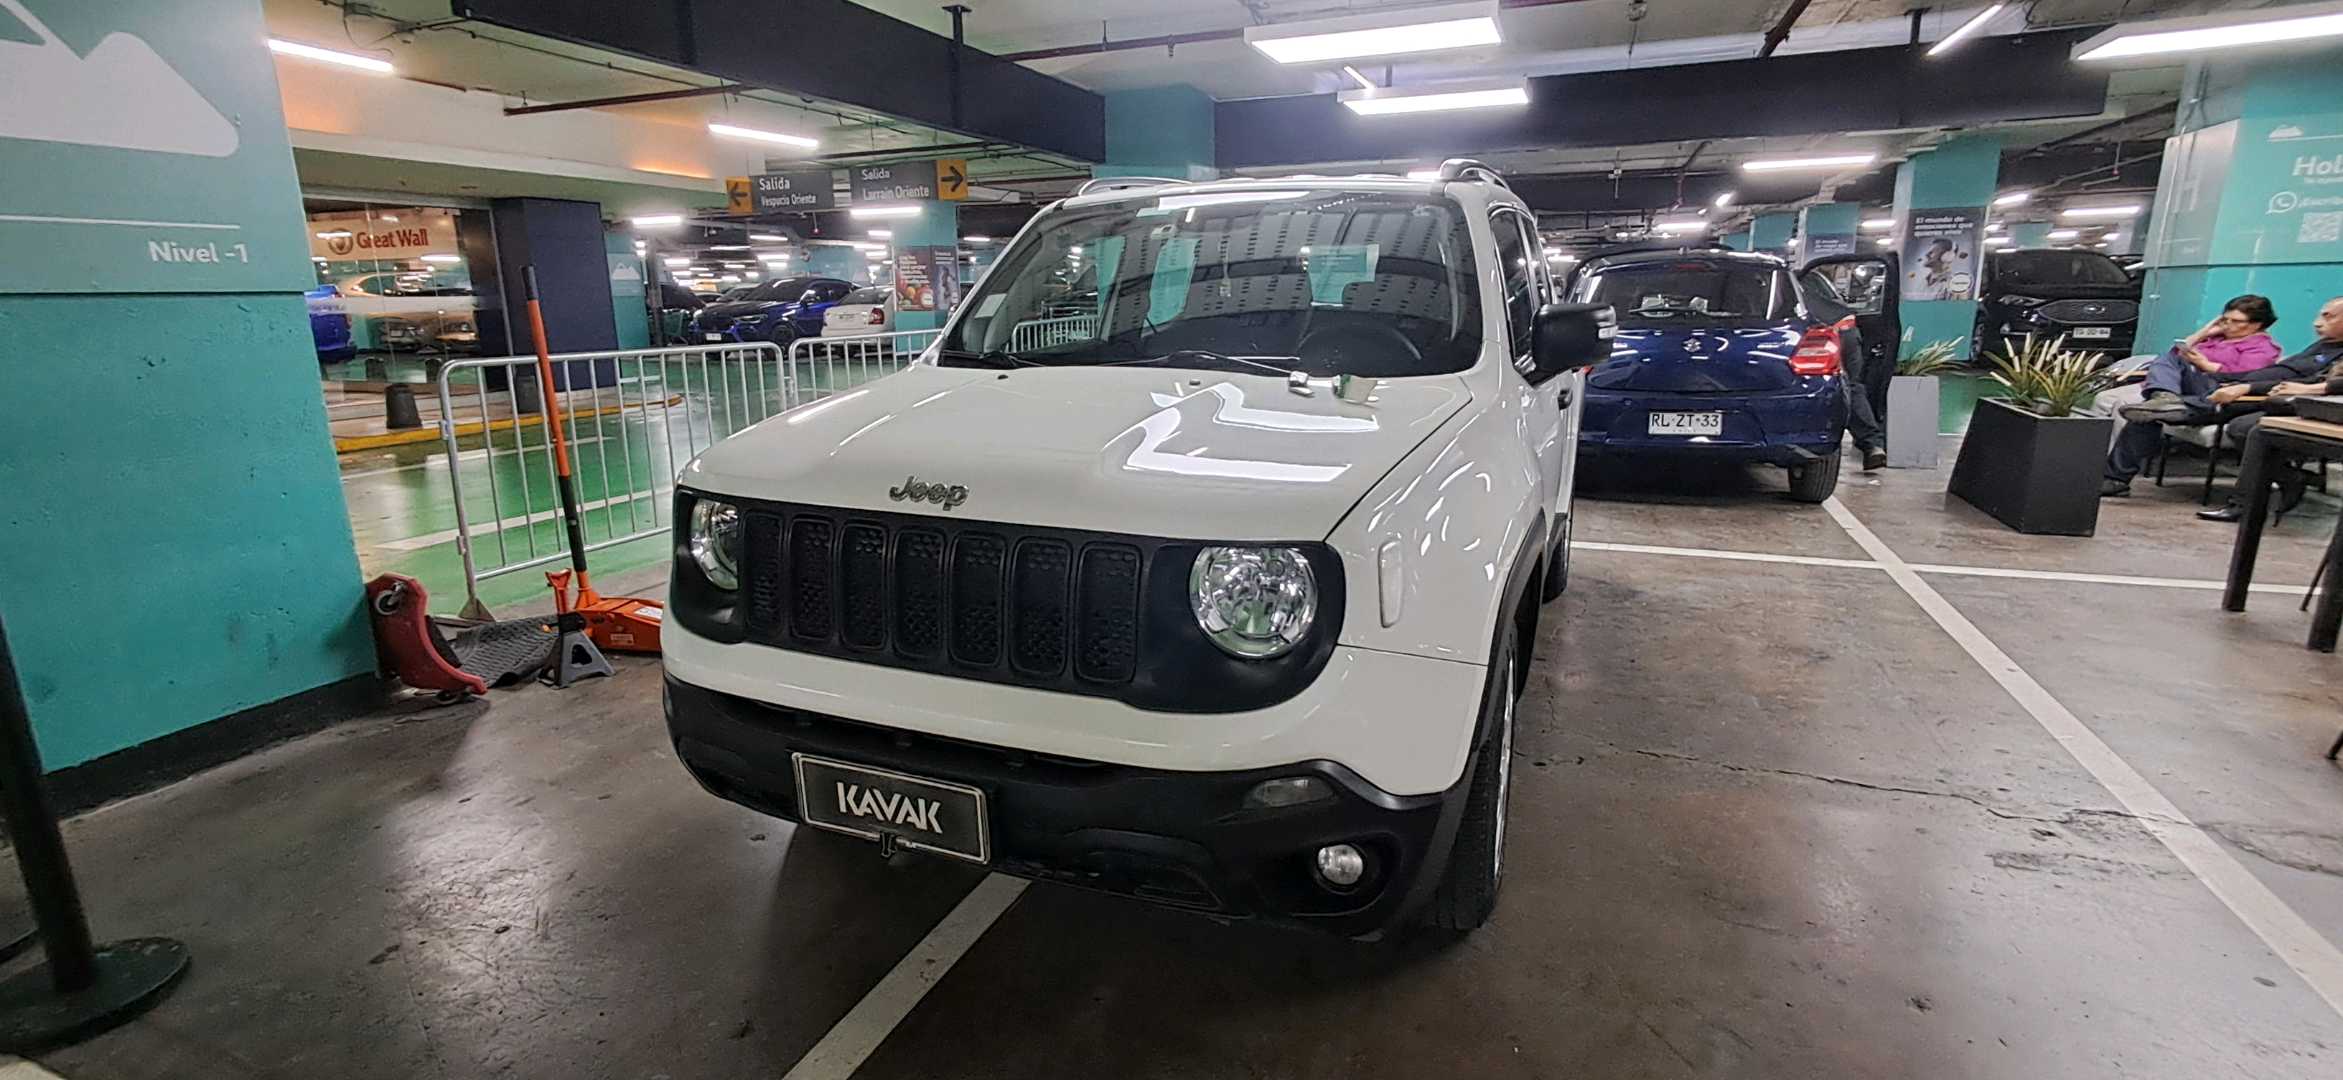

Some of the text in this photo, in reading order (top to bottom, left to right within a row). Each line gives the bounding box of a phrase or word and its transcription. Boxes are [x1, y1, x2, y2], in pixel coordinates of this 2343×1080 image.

[862, 168, 890, 180] Salida
[2292, 154, 2343, 176] Hol
[759, 177, 790, 191] Salida
[895, 184, 930, 199] Oriente
[791, 192, 817, 205] Oriente
[356, 228, 429, 249] Great Wall
[148, 241, 248, 263] Nivel -1
[889, 475, 969, 512] Jeep
[836, 781, 943, 834] KAVAK
